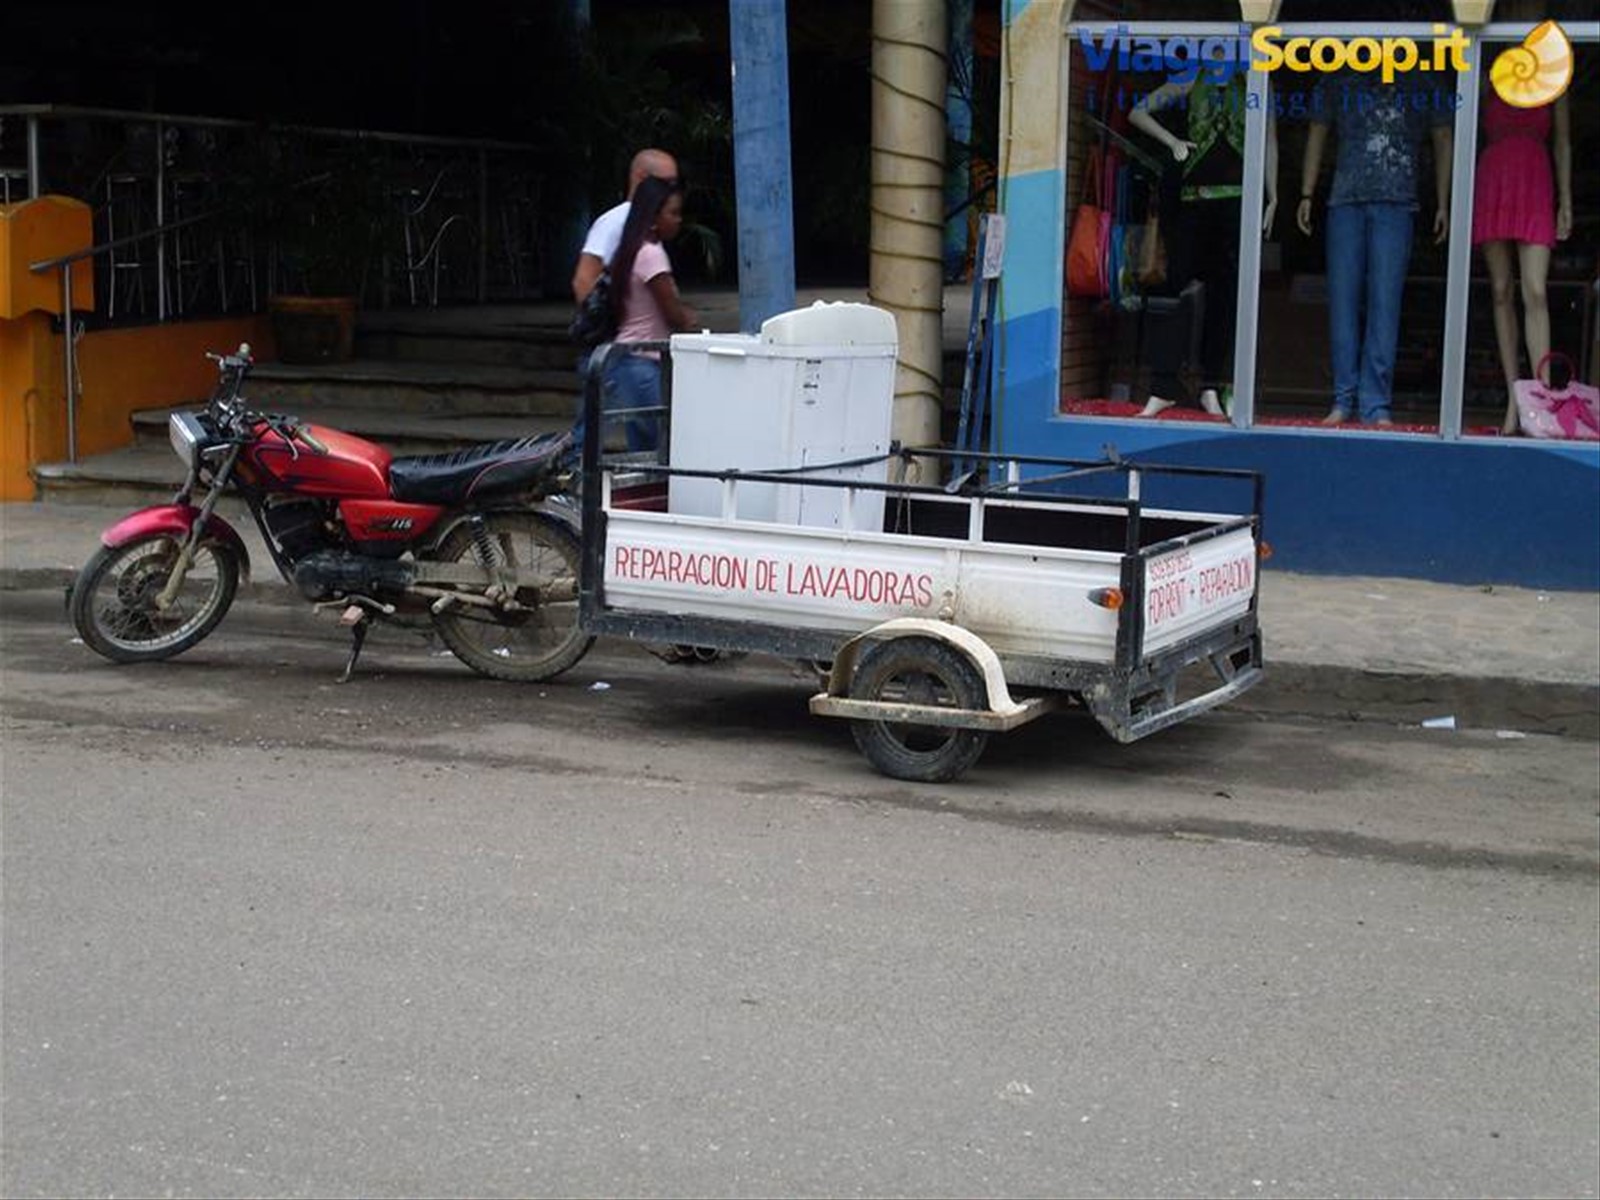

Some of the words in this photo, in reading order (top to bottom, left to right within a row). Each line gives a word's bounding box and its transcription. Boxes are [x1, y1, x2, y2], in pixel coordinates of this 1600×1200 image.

[615, 546, 748, 589] REPARACION
[755, 560, 779, 592] DE
[786, 563, 933, 607] LAVADORAS
